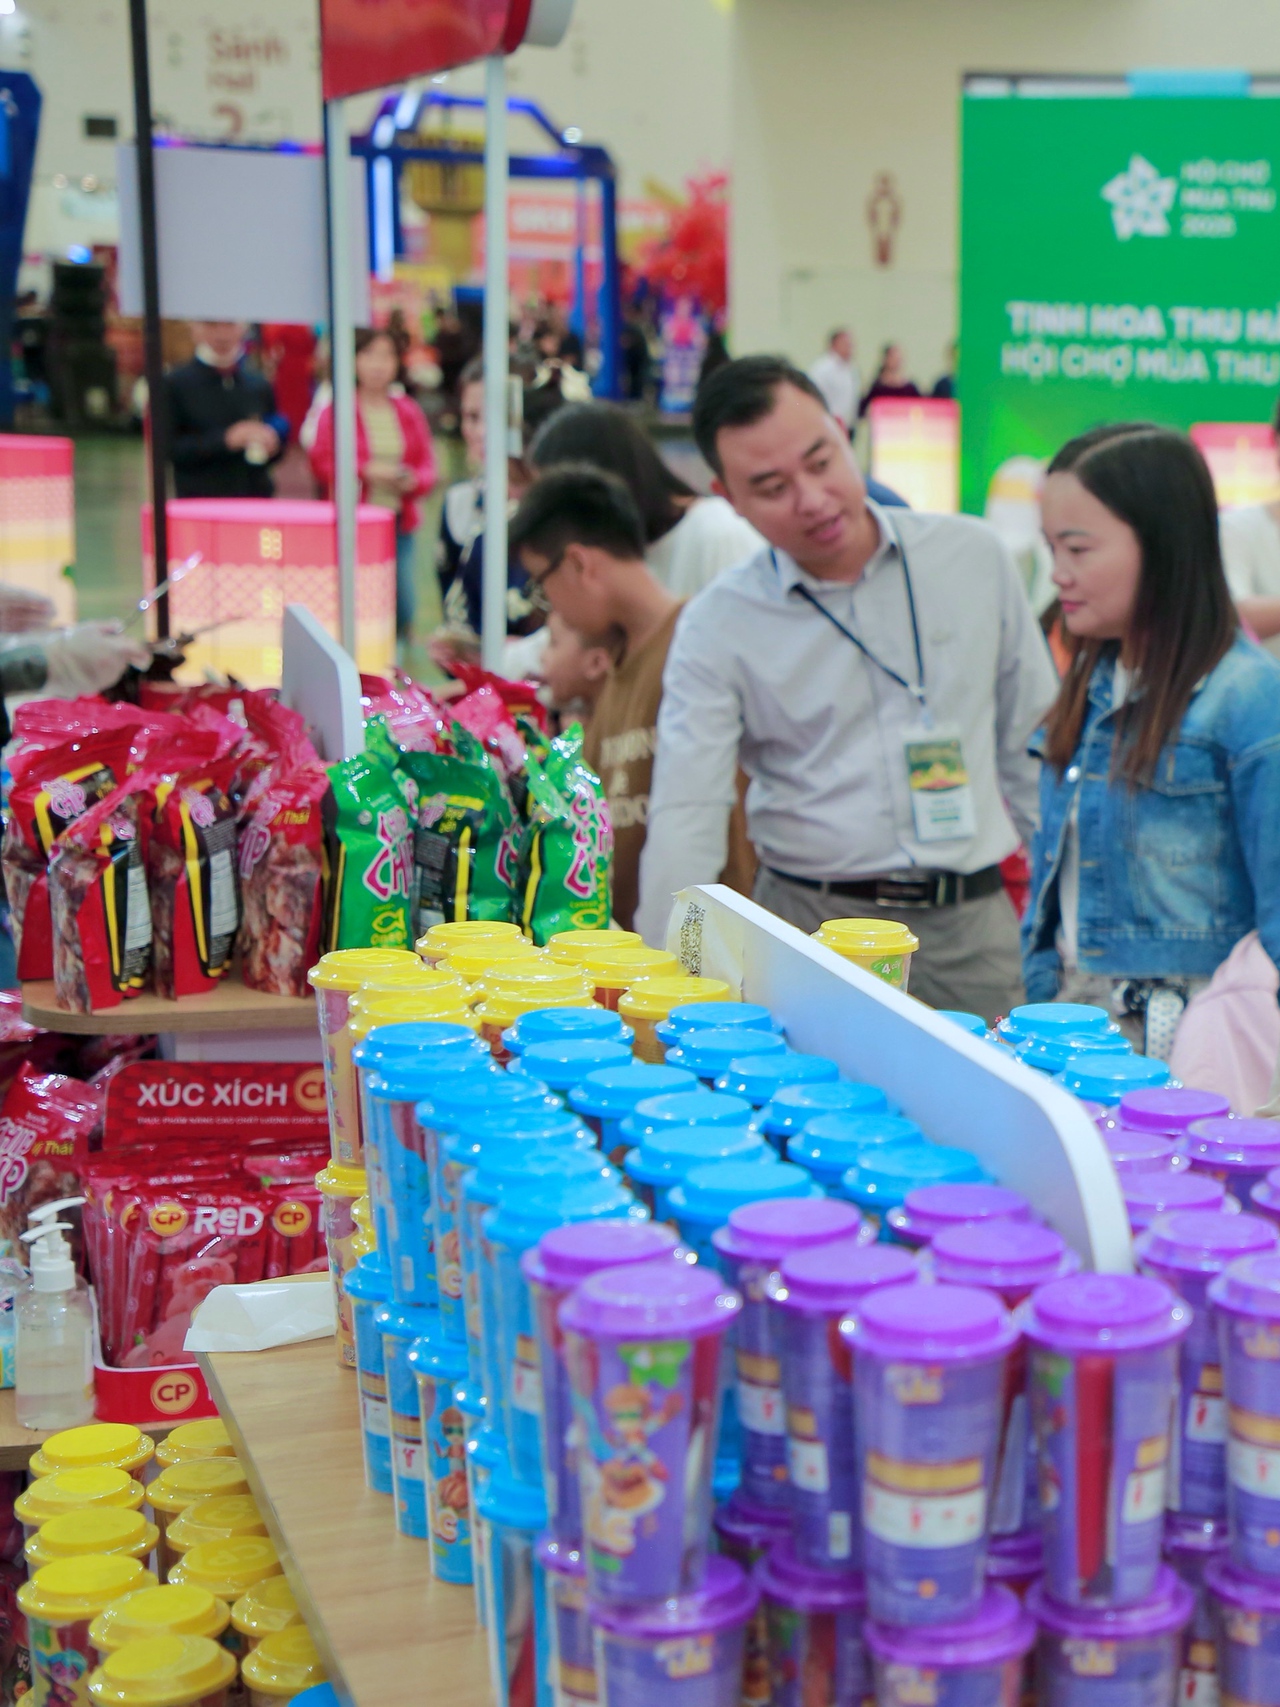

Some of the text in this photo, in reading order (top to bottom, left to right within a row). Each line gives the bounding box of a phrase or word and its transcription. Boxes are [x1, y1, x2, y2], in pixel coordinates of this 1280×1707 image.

[1006, 301, 1086, 338] TINH
[1090, 305, 1166, 340] HOA
[1169, 306, 1242, 343] THU
[1002, 340, 1058, 383] HỘI
[1061, 344, 1134, 387] CHỢ
[1138, 341, 1209, 382] MÙA
[1213, 349, 1280, 386] THU
[137, 1078, 287, 1107] XÚC XÍCH
[155, 1212, 182, 1225] CP
[279, 1211, 305, 1225] CP
[157, 1383, 191, 1402] CP
